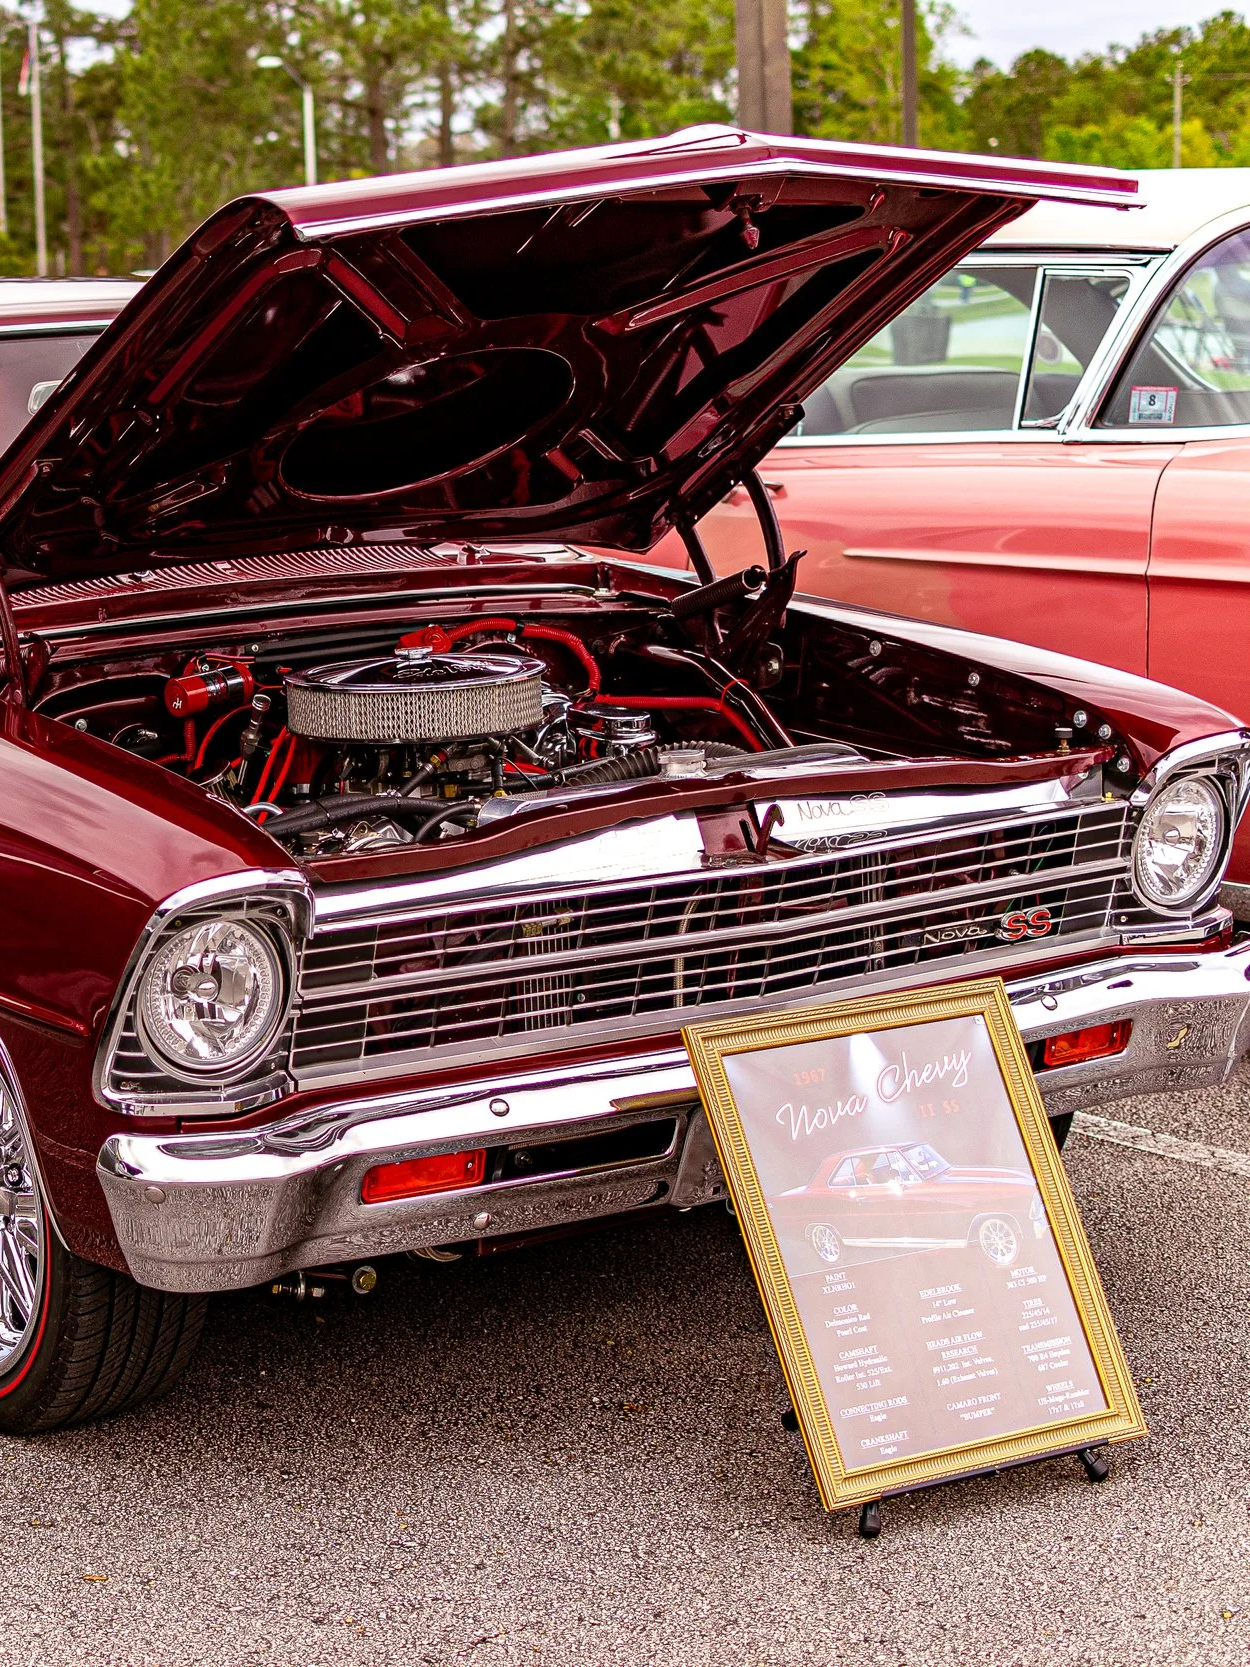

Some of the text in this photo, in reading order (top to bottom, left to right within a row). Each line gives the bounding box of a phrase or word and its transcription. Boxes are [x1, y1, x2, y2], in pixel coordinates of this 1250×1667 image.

[1148, 394, 1156, 406] 8
[797, 801, 850, 821] Nova
[923, 907, 1052, 945] Nova SS
[793, 1068, 826, 1085] 1967
[775, 1049, 971, 1140] Nova Chevy
[942, 1099, 960, 1114] SS
[825, 1272, 847, 1283] PAINT
[1010, 1266, 1036, 1277] MOTOR
[833, 1304, 858, 1314] COLOR
[1022, 1298, 1043, 1308] TIRES
[942, 1312, 952, 1320] Air
[926, 1330, 983, 1349] HEADS AIR FLOW
[839, 1345, 878, 1359] CAMSHAFT
[941, 1345, 978, 1359] RESEARCH
[1046, 1380, 1074, 1392] WHEELS
[840, 1396, 908, 1417] CONNECTING RODS
[946, 1392, 1001, 1411] CAMARO FRONT
[869, 1412, 887, 1423] Eagle
[861, 1430, 908, 1447] CRANKSHAFT
[880, 1445, 898, 1455] Eagle
